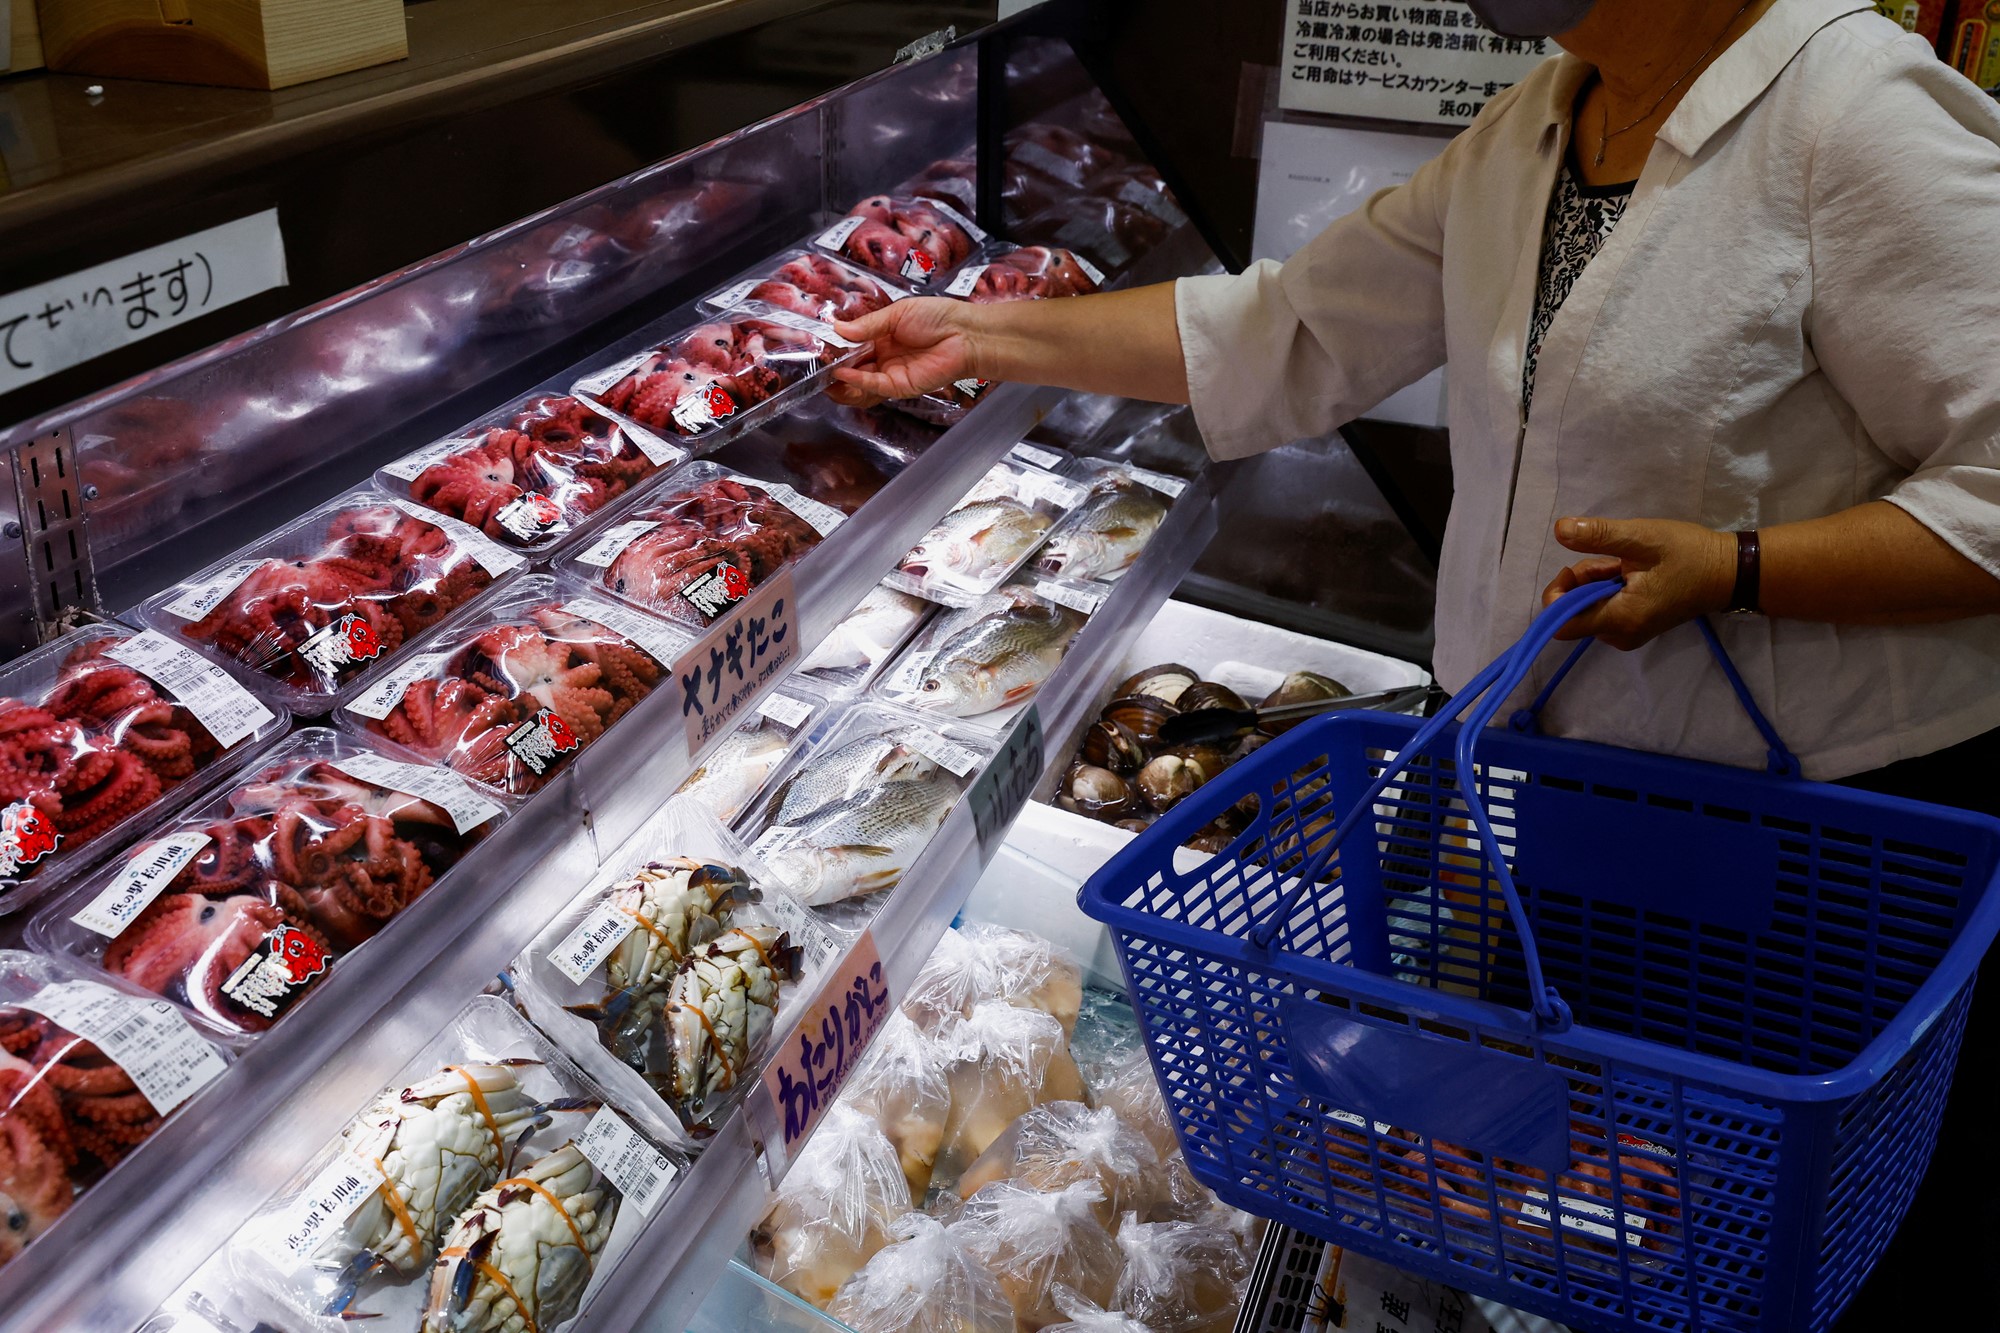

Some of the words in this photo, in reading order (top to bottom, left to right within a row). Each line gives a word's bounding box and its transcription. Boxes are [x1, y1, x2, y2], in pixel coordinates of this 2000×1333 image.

[1294, 43, 1402, 69] ご利用ください。
[682, 598, 787, 717] ヤナギたこ
[105, 879, 148, 917] 浜の駅
[140, 844, 184, 880] 松川浦
[570, 939, 599, 967] 浜の駅
[591, 918, 620, 944] 松川浦
[777, 960, 889, 1145] わたりがに
[586, 1118, 608, 1145] わたりがに
[284, 1211, 324, 1250] 浜の駅
[319, 1175, 361, 1214] 松川浦
